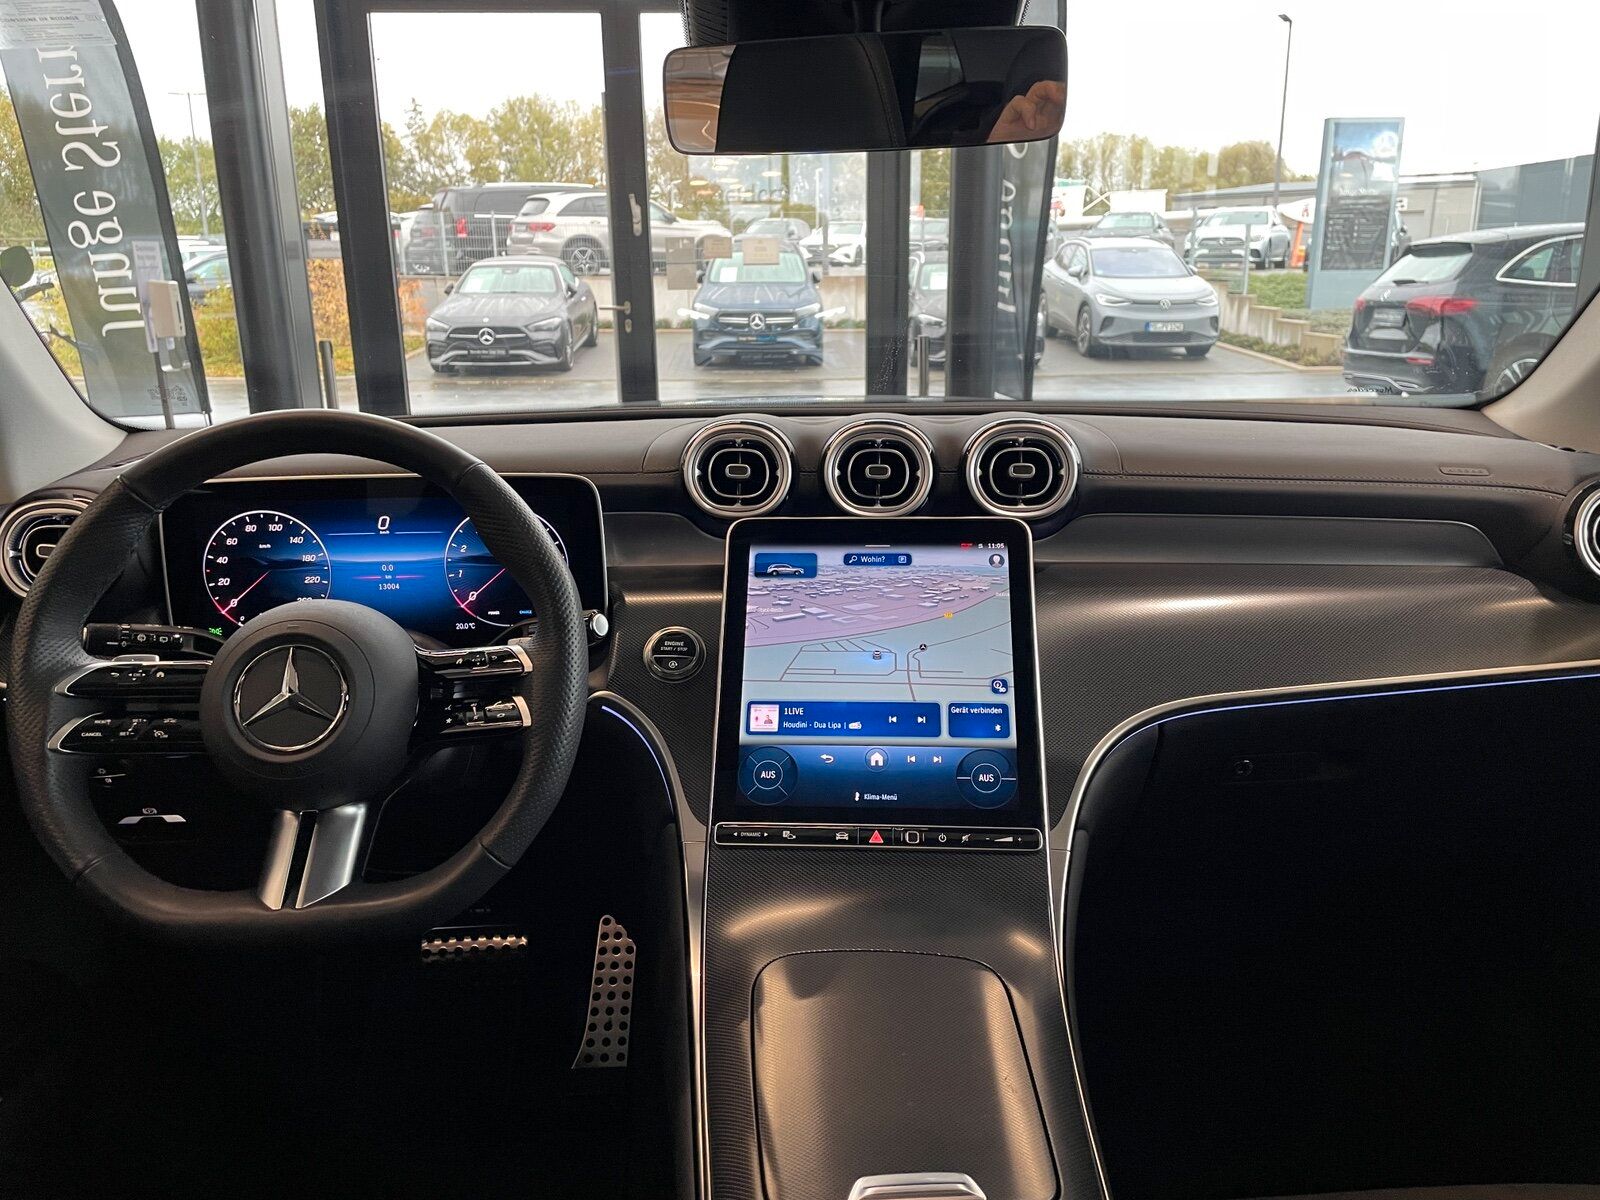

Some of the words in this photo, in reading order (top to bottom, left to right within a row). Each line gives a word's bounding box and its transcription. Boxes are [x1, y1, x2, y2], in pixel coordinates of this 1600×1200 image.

[378, 515, 390, 530] 0
[245, 524, 257, 533] 80
[268, 523, 283, 532] 100
[226, 537, 238, 546] 60
[289, 536, 303, 544] 140
[460, 544, 467, 553] 2
[216, 556, 228, 564] 40
[302, 554, 316, 562] 180
[860, 555, 885, 563] Wohin?
[381, 564, 394, 572] 0.0
[458, 569, 463, 577] 1
[217, 577, 230, 586] 20
[304, 576, 320, 584] 220
[784, 707, 804, 716] 1LIVE
[950, 706, 969, 714] Gerät
[970, 706, 1003, 714] verbinden
[783, 721, 808, 729] Houdini
[813, 721, 827, 729] Dua
[828, 721, 841, 730] Lipa
[760, 770, 776, 780] AUS
[978, 773, 994, 783] AUS
[864, 792, 898, 801] Klima-Menü
